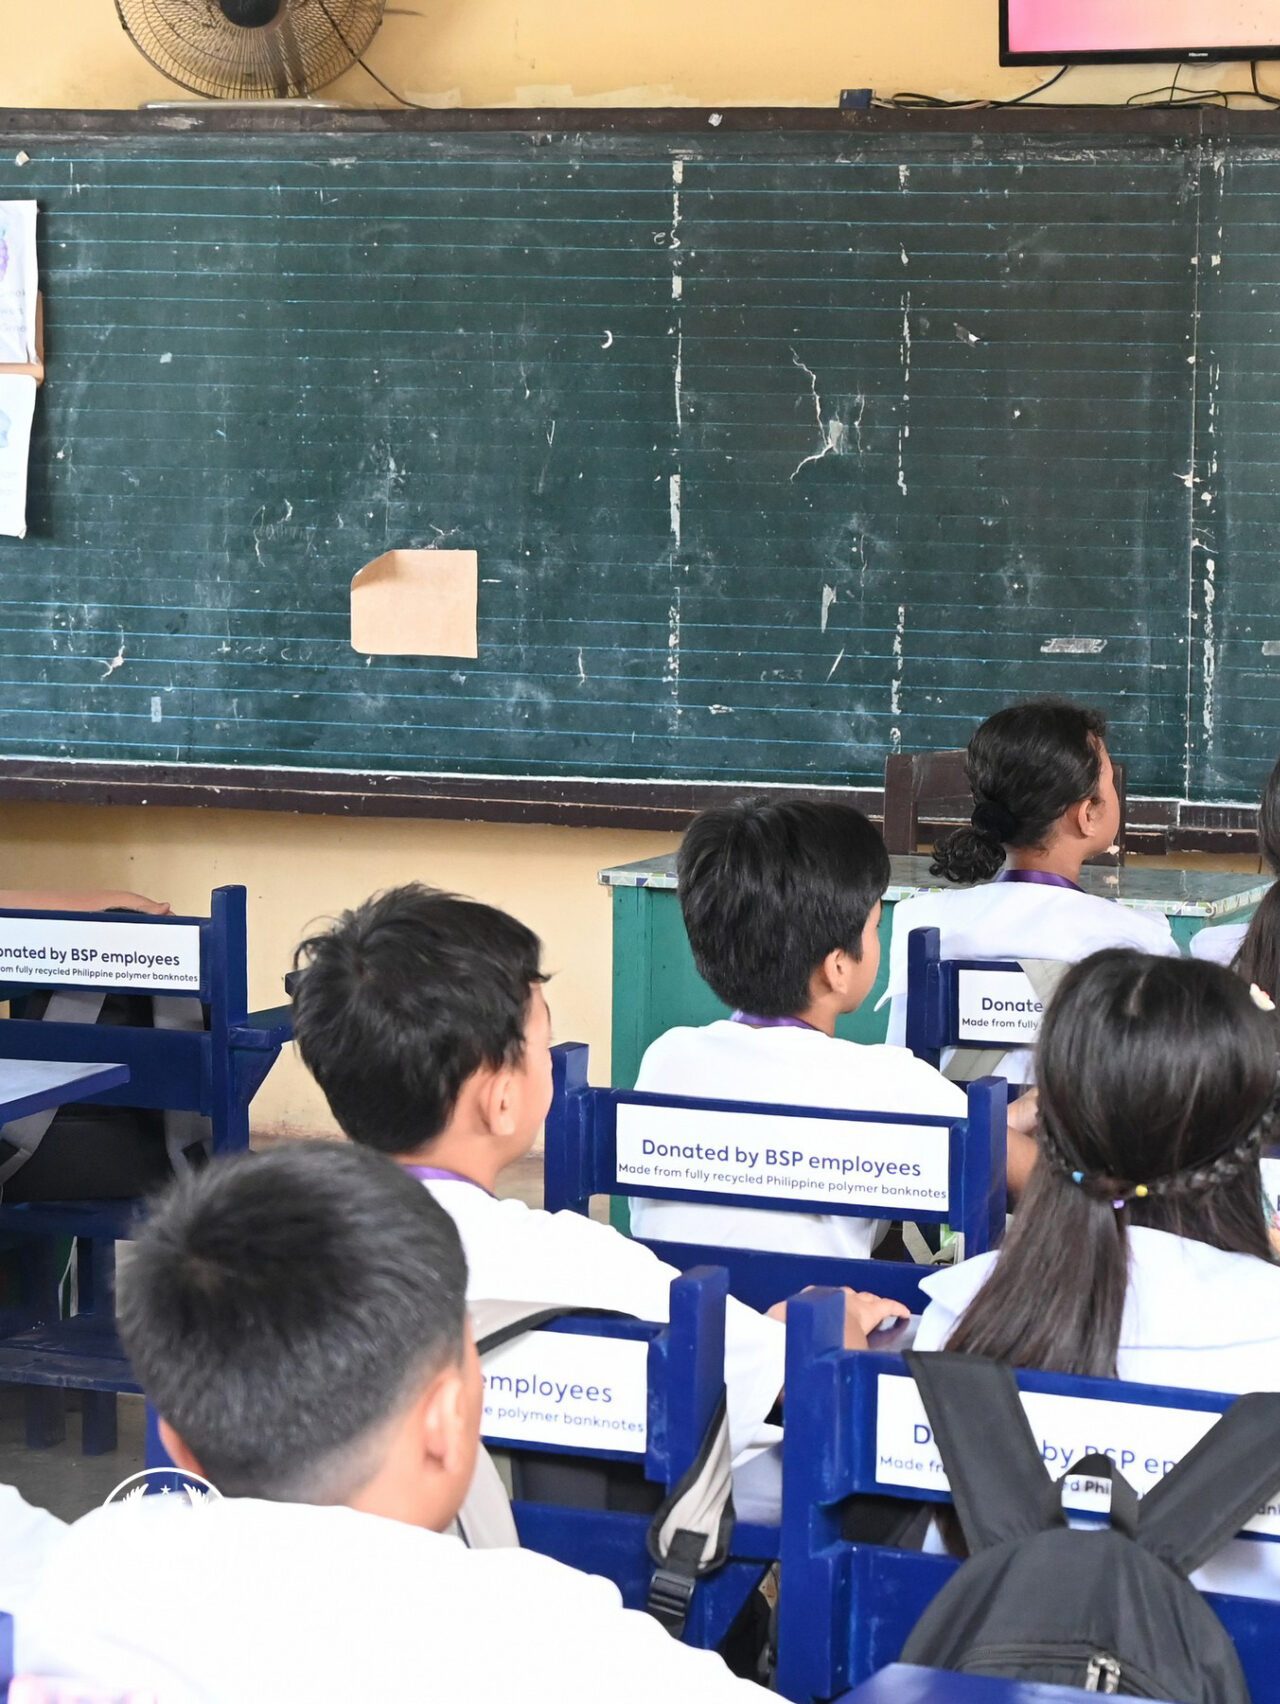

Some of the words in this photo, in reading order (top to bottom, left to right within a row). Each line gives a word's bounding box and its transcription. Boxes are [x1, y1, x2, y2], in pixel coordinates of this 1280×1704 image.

[0, 946, 46, 959] nated
[50, 947, 67, 963] by
[71, 948, 98, 961] BSP
[101, 951, 180, 968] employees
[16, 965, 33, 975] fully
[35, 968, 70, 976] recycled
[72, 968, 113, 978] Philippine
[115, 971, 151, 980] polymer
[152, 972, 198, 982] banknotes
[981, 996, 1044, 1013] Donate
[962, 1018, 989, 1026] Made
[992, 1019, 1015, 1027] from
[1017, 1018, 1039, 1031] fully
[643, 1139, 728, 1161] Donated
[736, 1147, 759, 1168] by
[766, 1149, 803, 1166] BSP
[809, 1156, 921, 1178] employees
[619, 1163, 650, 1174] Made
[654, 1166, 681, 1177] from
[685, 1168, 710, 1183] fully
[713, 1173, 763, 1184] recycled
[767, 1176, 825, 1190] Philippine
[829, 1177, 879, 1194] polymer
[882, 1184, 946, 1199] banknotes
[482, 1373, 613, 1404] mployees
[498, 1408, 559, 1422] polymer
[564, 1413, 644, 1433] banknotes
[880, 1456, 923, 1471] Made
[1043, 1439, 1075, 1469] by
